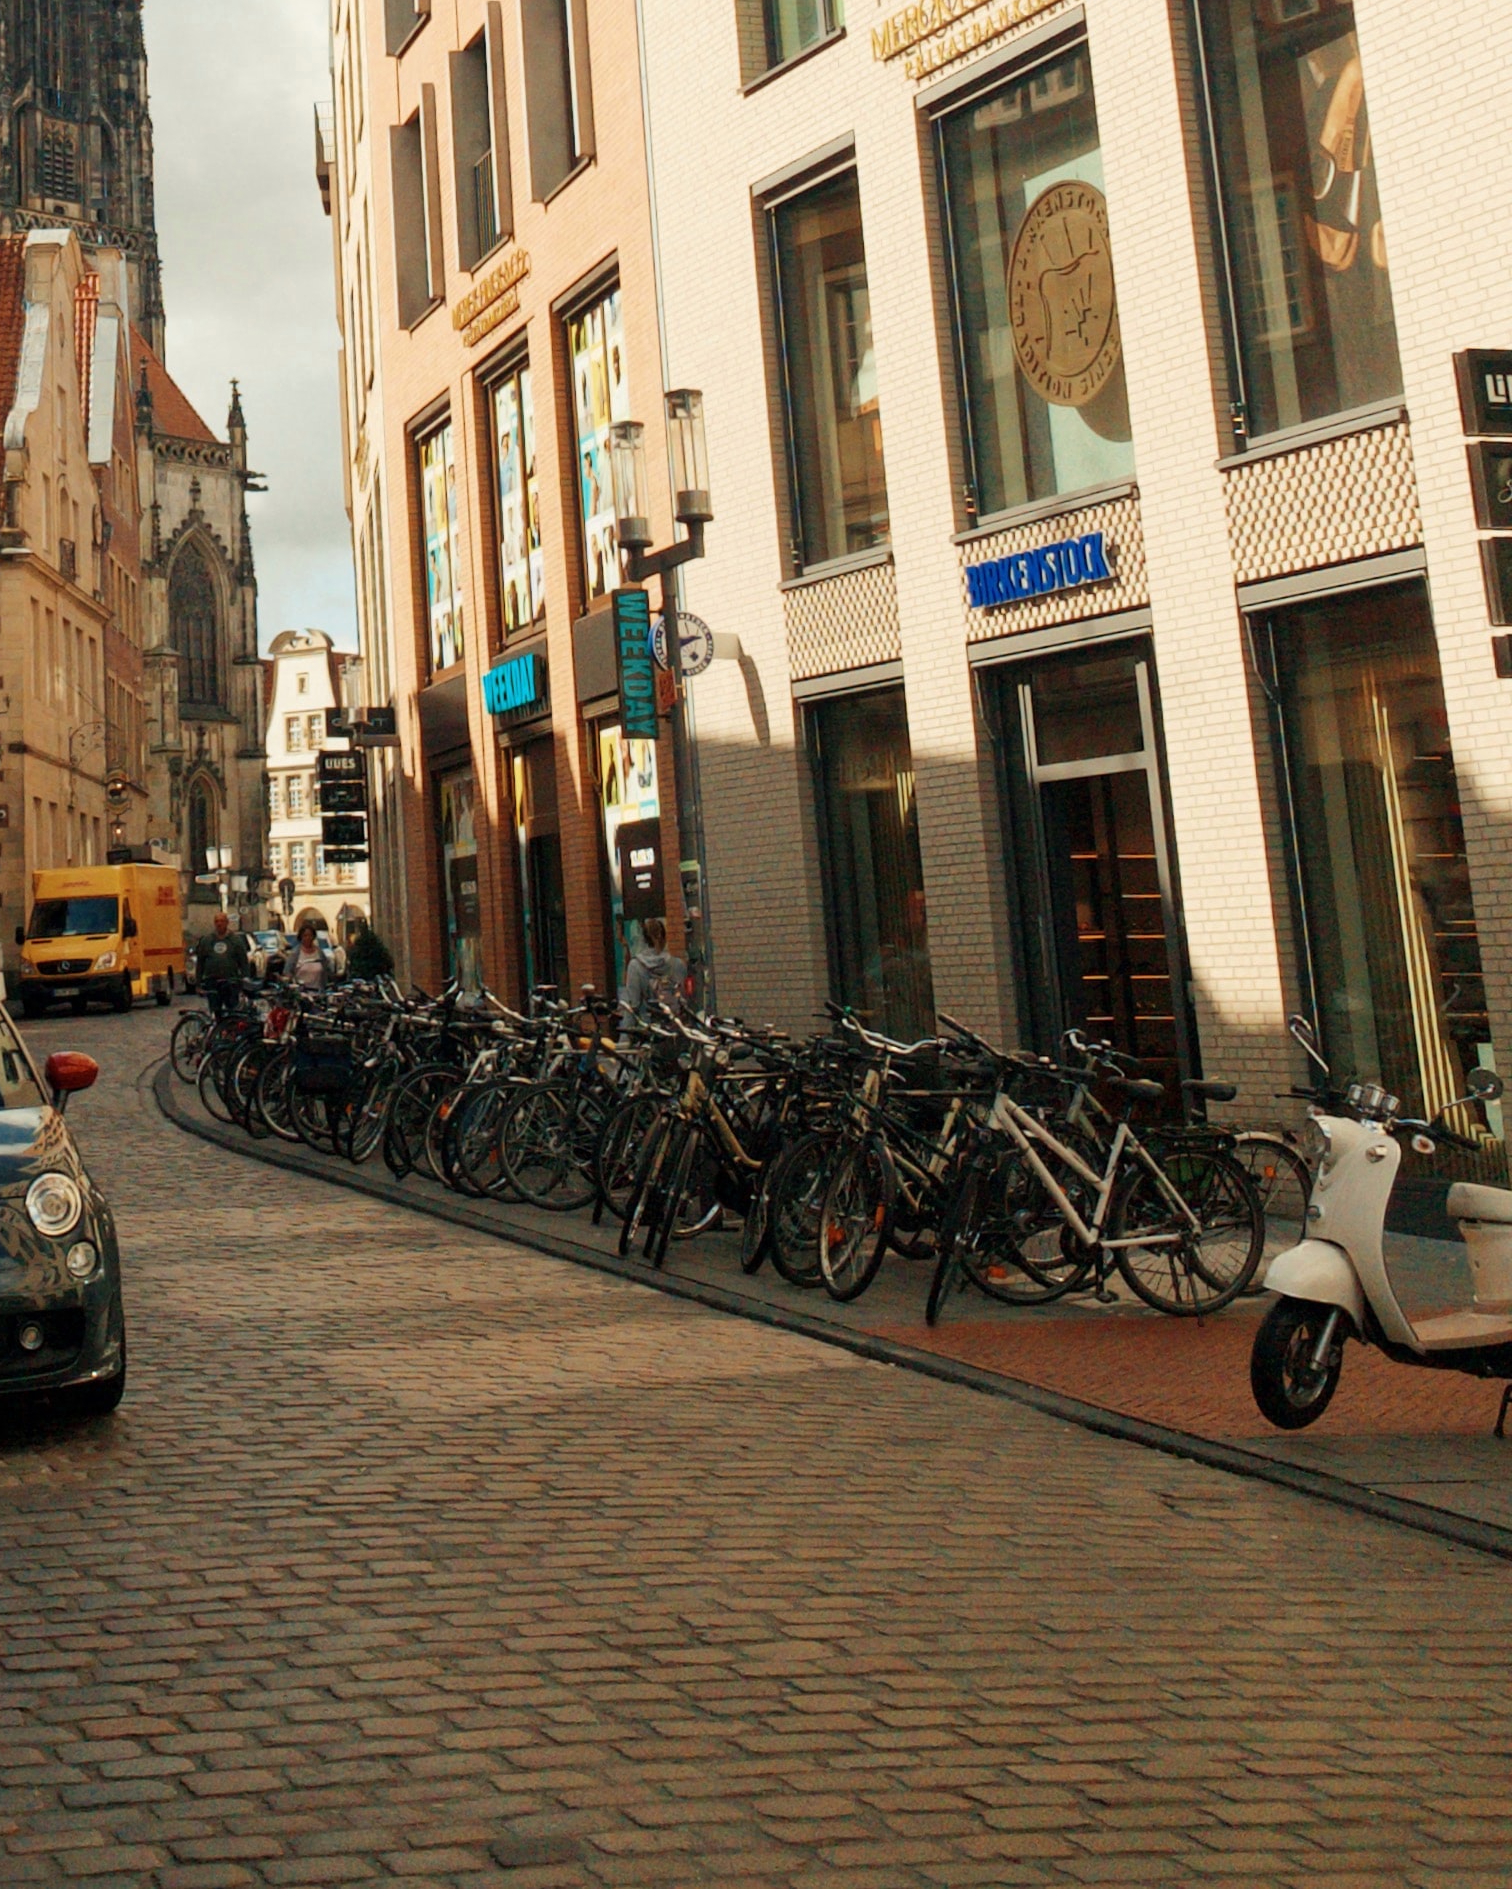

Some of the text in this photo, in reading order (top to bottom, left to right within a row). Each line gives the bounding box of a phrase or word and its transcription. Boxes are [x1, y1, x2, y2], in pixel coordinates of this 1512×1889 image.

[965, 531, 1110, 608] BIRKENSTOCK
[482, 653, 536, 715] WEEKDAY
[618, 592, 656, 737] WEEKDAY
